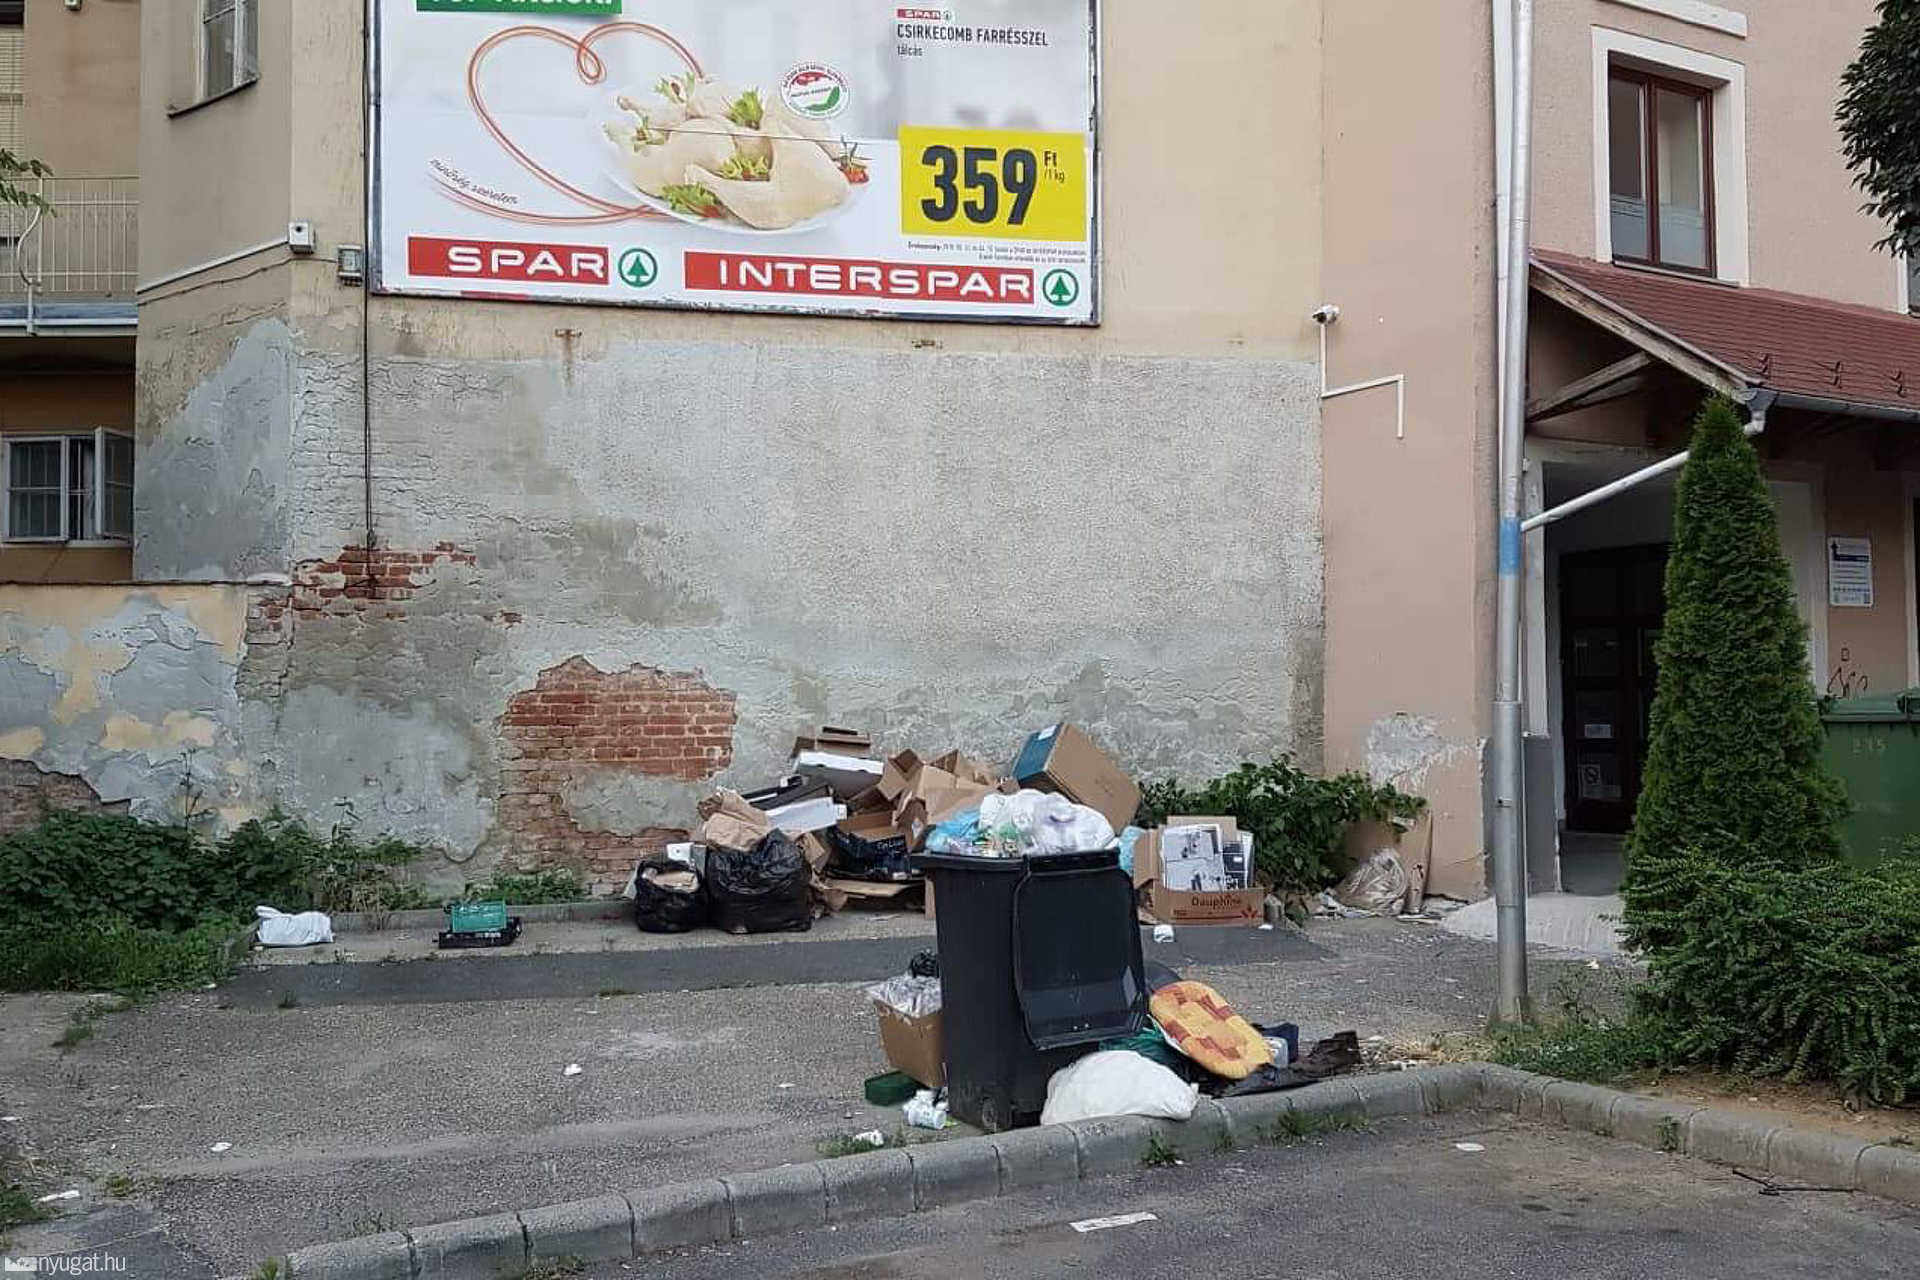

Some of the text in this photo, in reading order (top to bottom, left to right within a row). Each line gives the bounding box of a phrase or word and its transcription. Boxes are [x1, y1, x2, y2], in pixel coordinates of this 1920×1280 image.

[897, 23, 1049, 46] CSIRKECOMB FARRÉSSZEL
[1044, 150, 1057, 166] Ft
[921, 145, 1037, 225] 359
[447, 246, 604, 278] SPAR
[719, 258, 1031, 299] INTERSPAR
